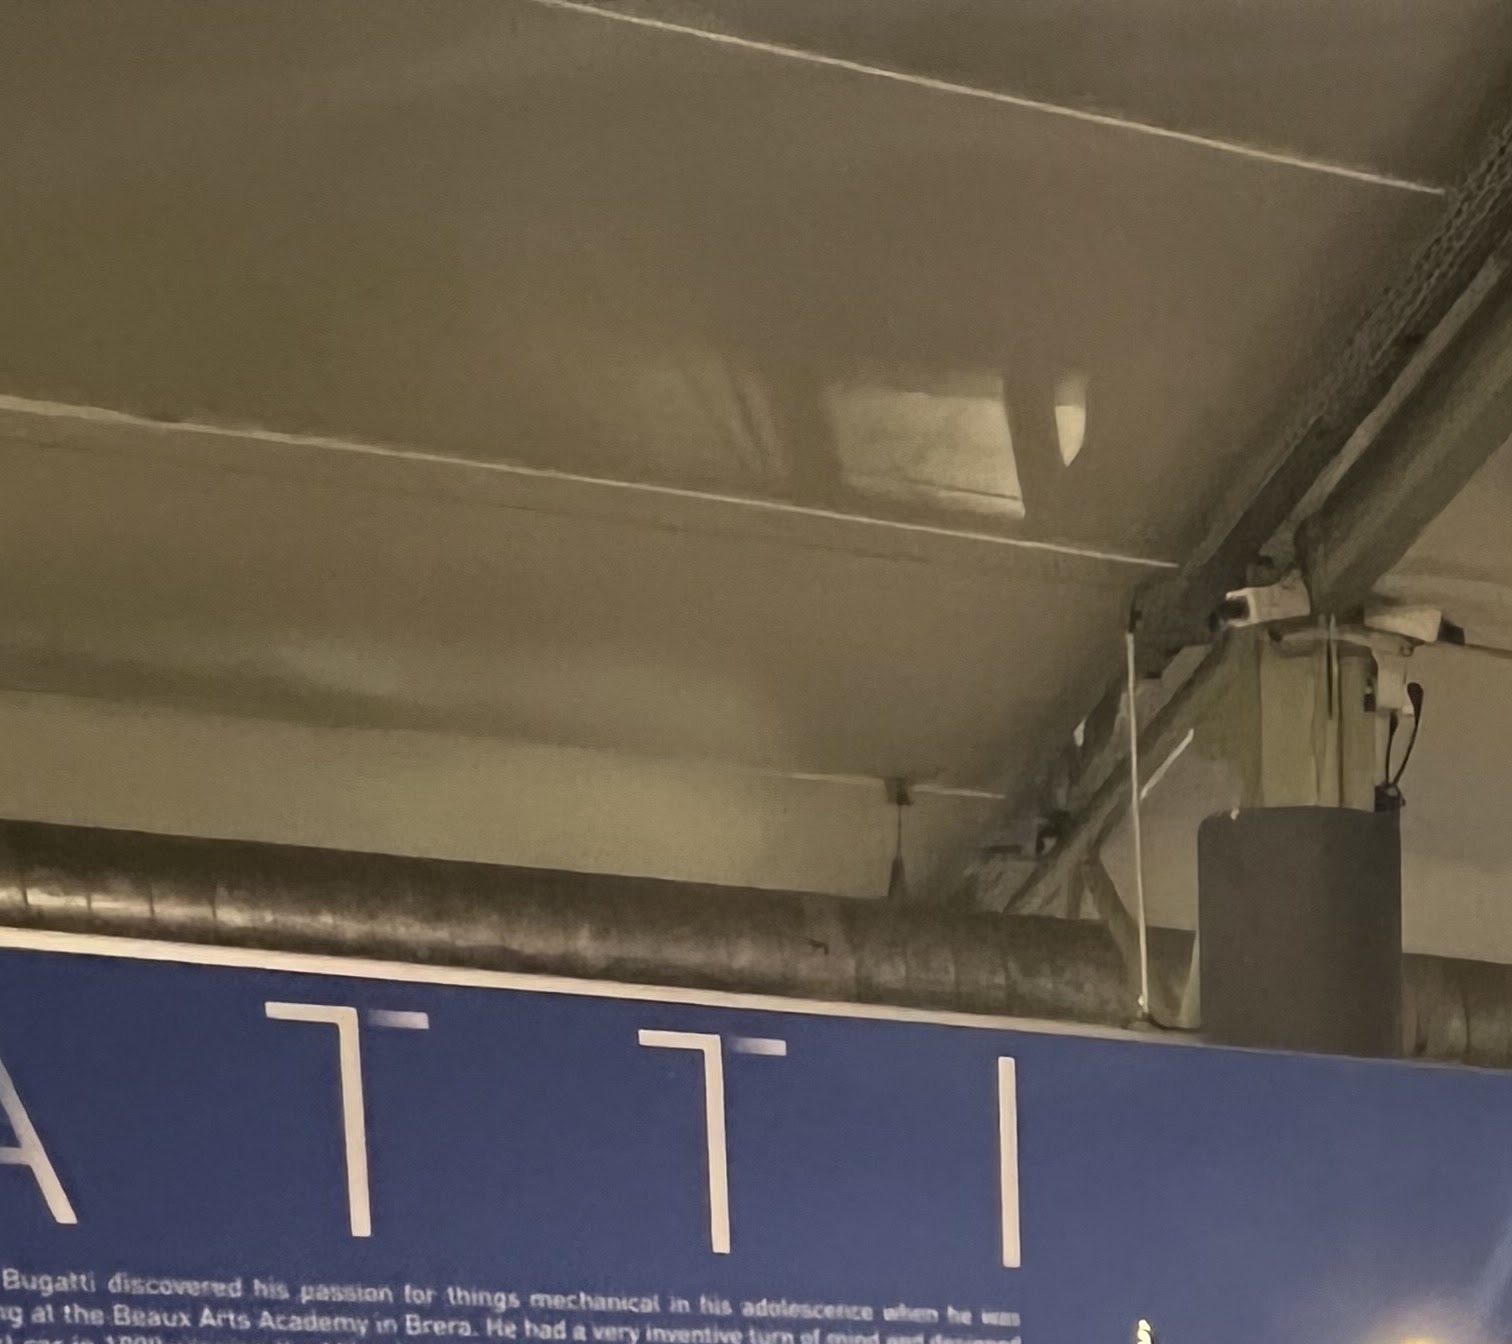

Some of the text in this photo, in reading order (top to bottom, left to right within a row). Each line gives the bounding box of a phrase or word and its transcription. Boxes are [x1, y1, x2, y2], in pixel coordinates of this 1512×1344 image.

[1, 1268, 96, 1299] Bugatti
[107, 1273, 244, 1299] discovered
[252, 1278, 290, 1301] his
[299, 1284, 394, 1309] passion
[403, 1284, 437, 1306] for
[446, 1286, 521, 1314] things
[529, 1291, 661, 1314] mechanical
[669, 1296, 691, 1314] in
[30, 1303, 55, 1325] at
[62, 1304, 105, 1326] the
[112, 1303, 192, 1328] Beaux
[198, 1307, 252, 1330] Arts
[257, 1310, 369, 1336] Academy
[375, 1315, 398, 1334] in
[485, 1317, 518, 1338] He
[523, 1318, 567, 1340] had
[572, 1324, 587, 1340] a
[645, 1326, 744, 1344] inventive
